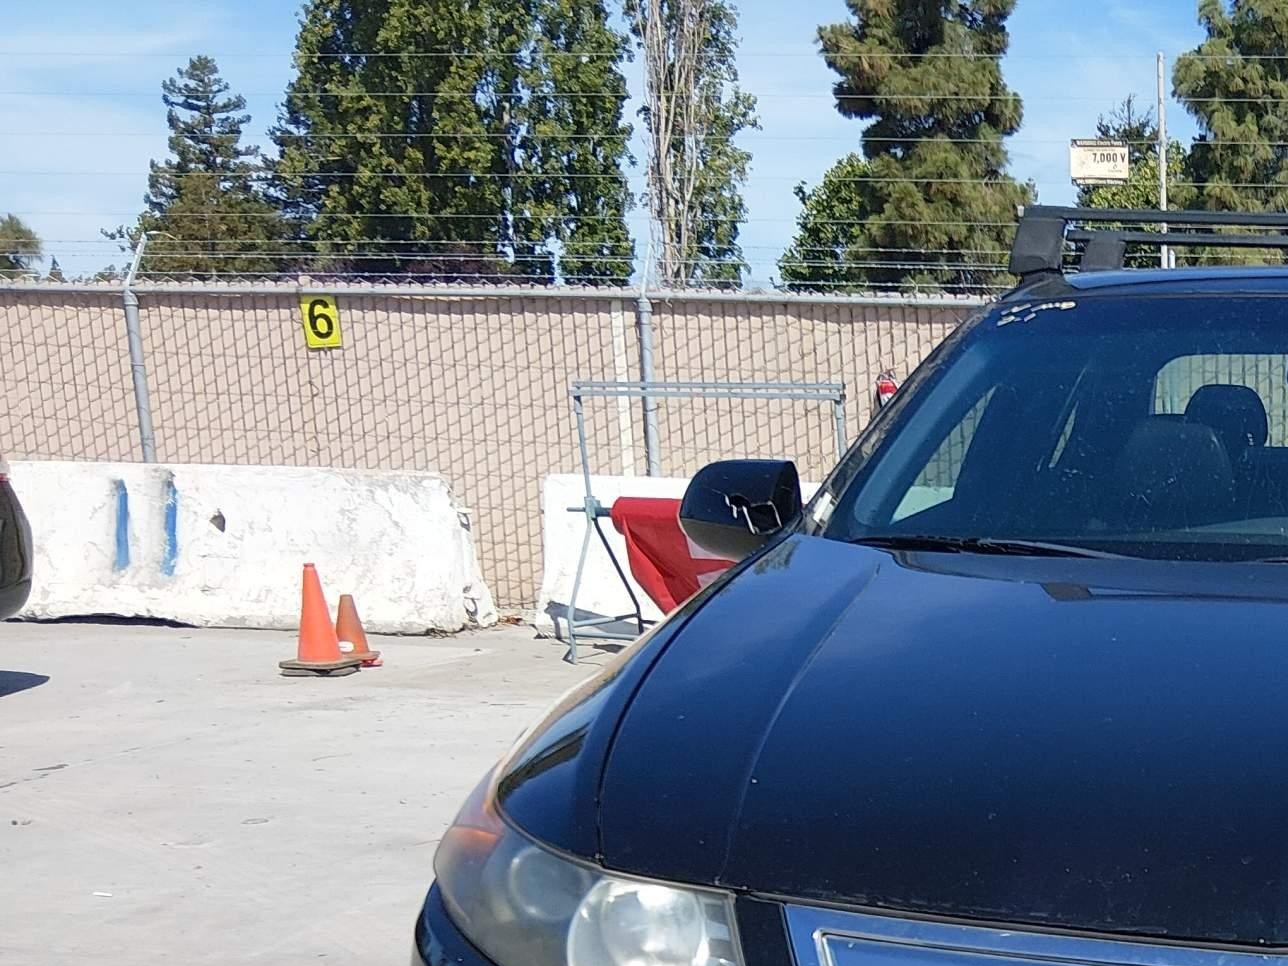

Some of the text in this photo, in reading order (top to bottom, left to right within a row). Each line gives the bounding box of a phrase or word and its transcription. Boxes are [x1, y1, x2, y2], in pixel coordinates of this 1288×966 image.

[1092, 152, 1126, 164] 7,000 V
[308, 299, 334, 339] 6
